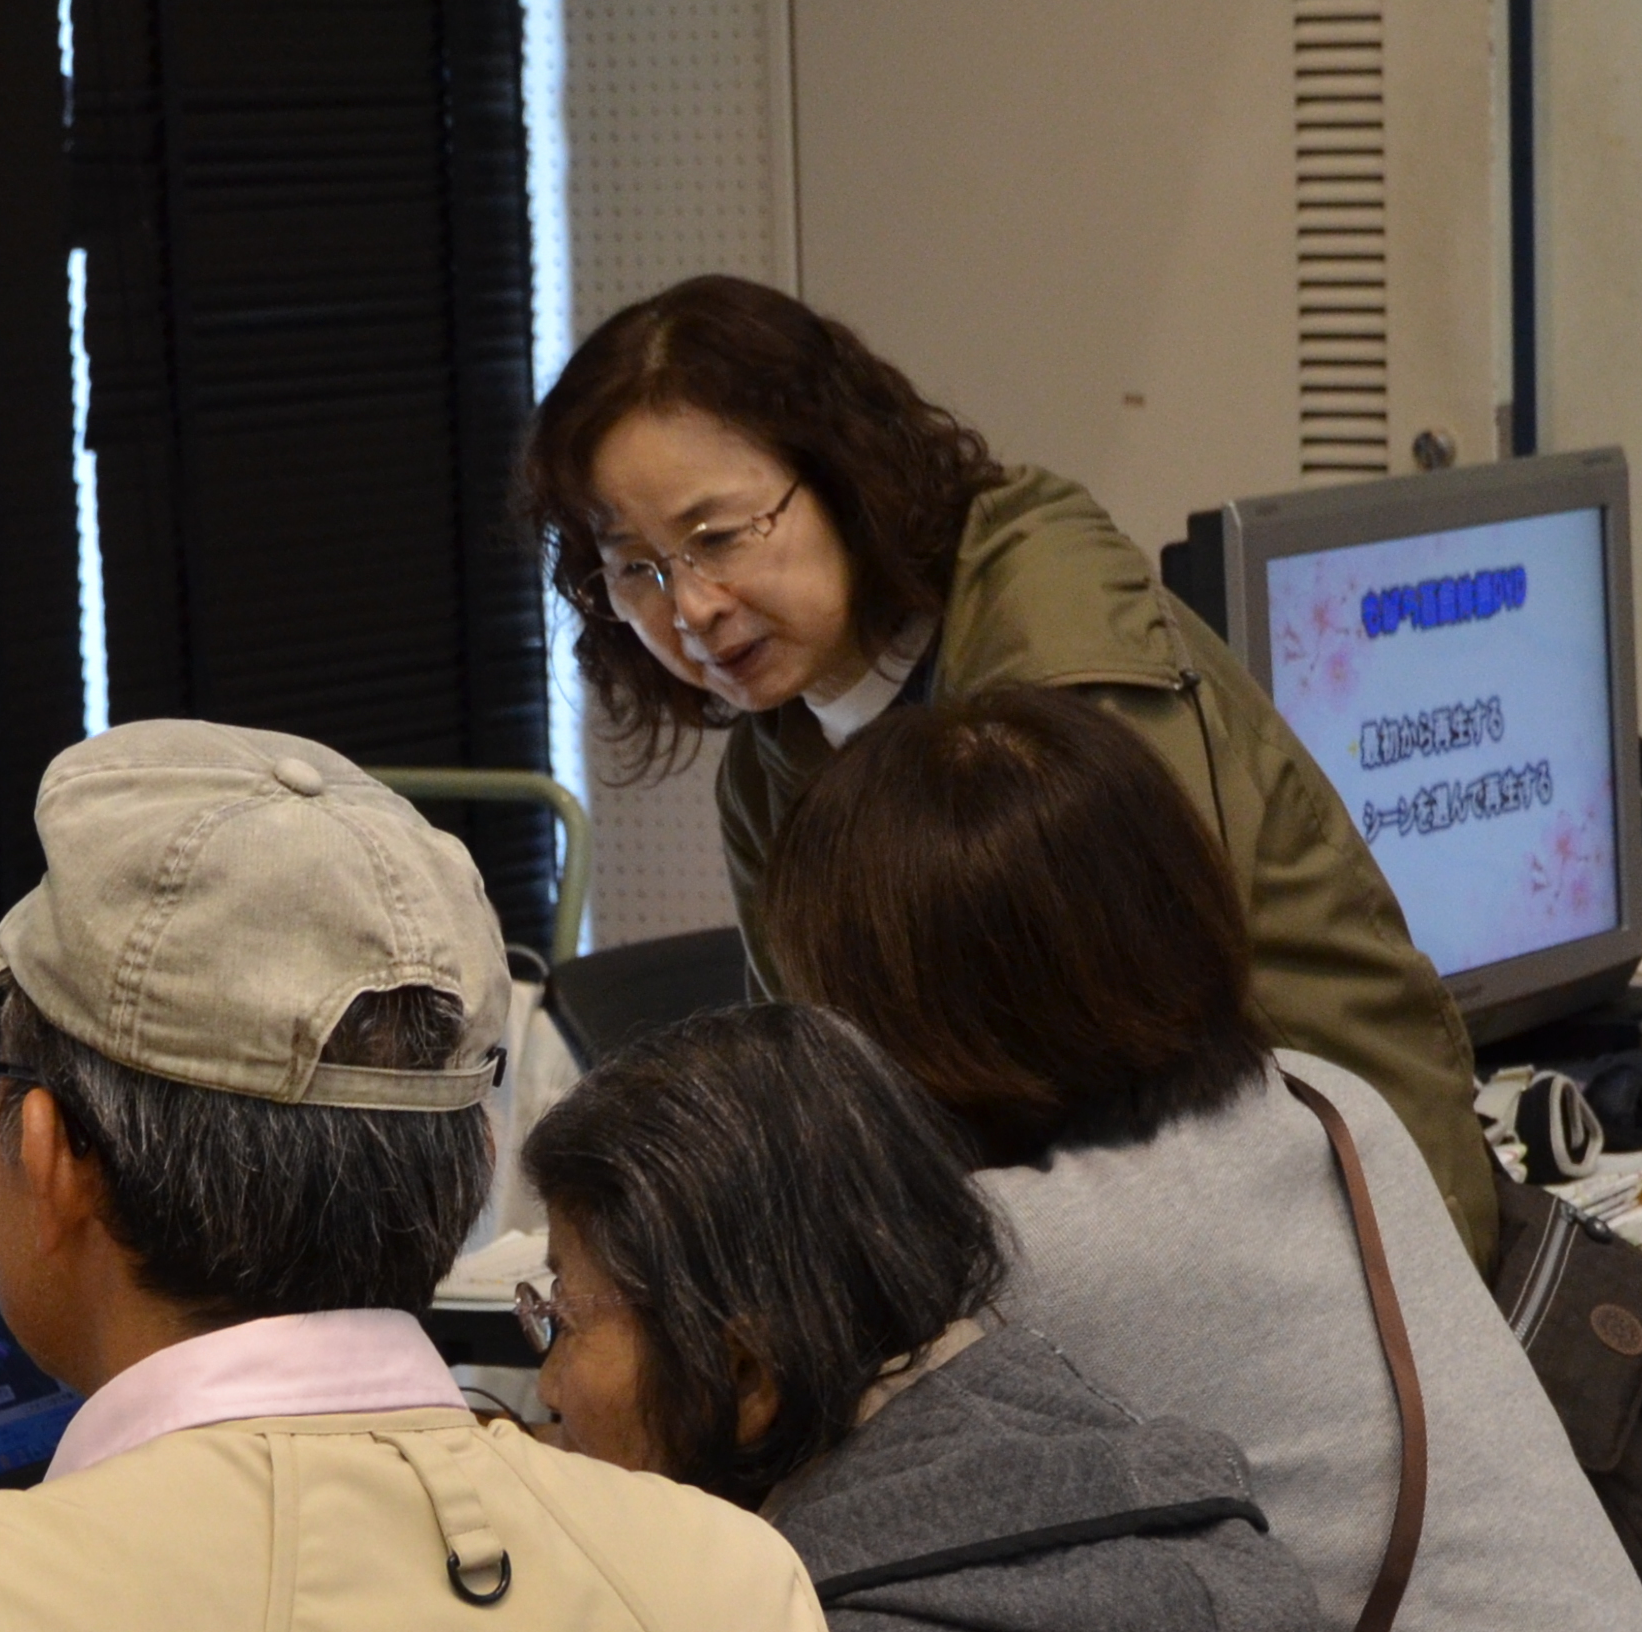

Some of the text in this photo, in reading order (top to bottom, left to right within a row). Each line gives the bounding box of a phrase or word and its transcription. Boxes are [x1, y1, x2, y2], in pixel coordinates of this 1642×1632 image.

[1360, 695, 1505, 771] 最初から再生する
[1362, 759, 1554, 844] シーンを選んで再生する
